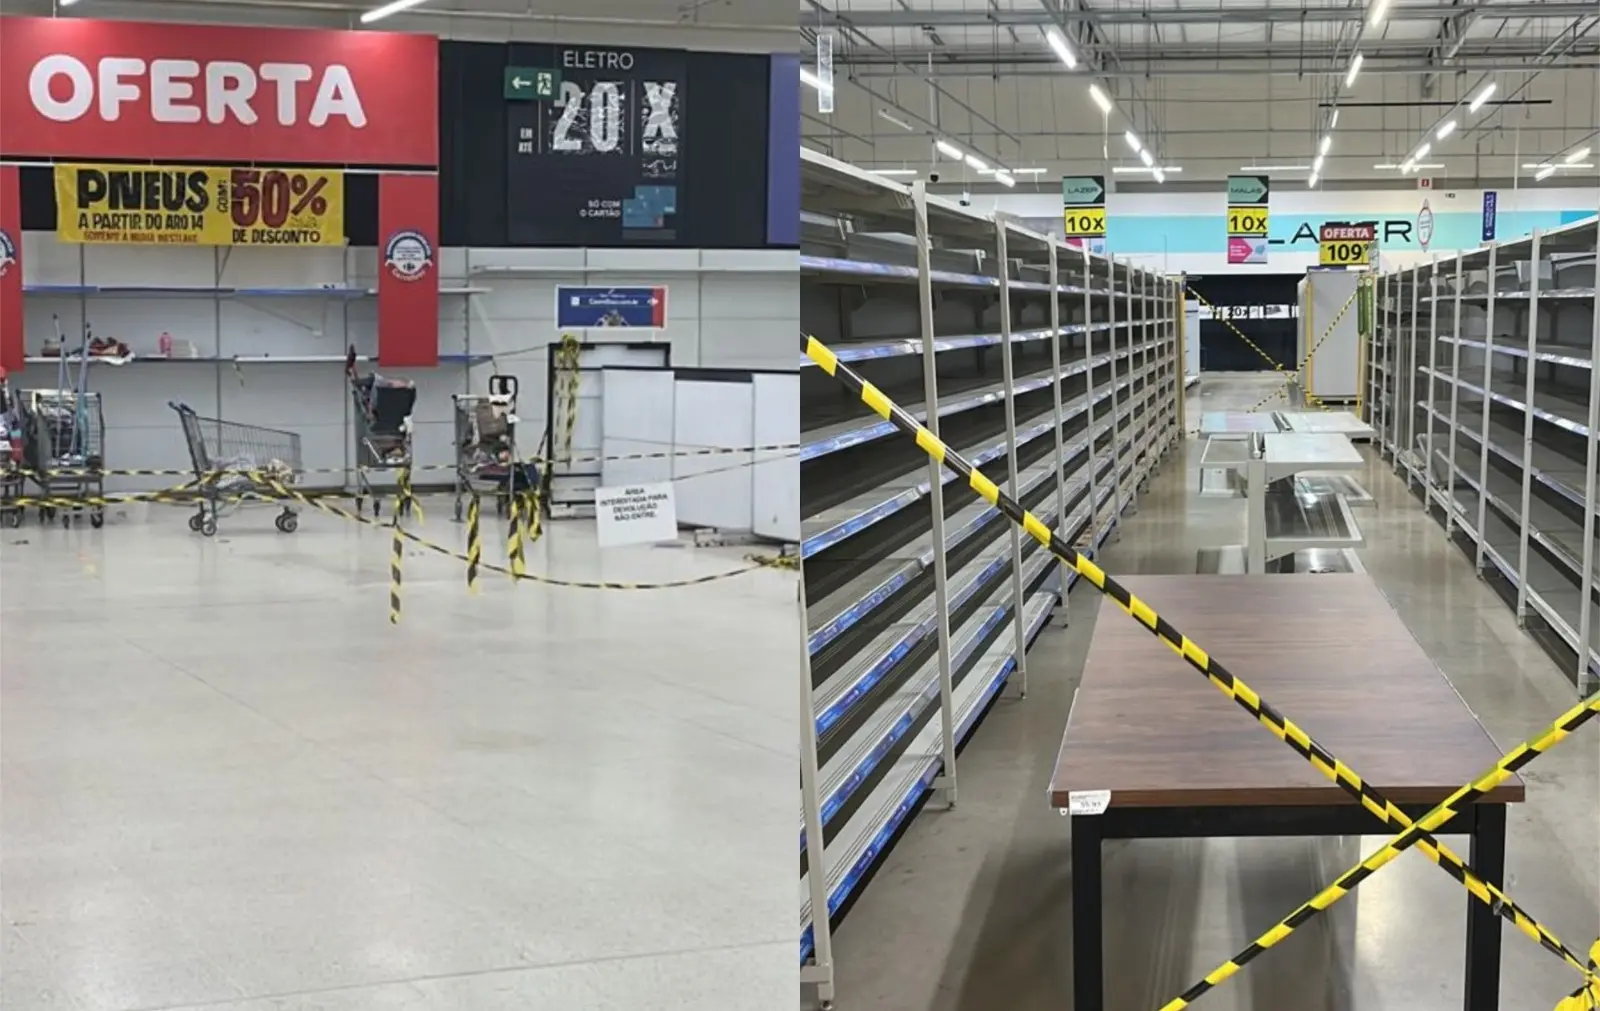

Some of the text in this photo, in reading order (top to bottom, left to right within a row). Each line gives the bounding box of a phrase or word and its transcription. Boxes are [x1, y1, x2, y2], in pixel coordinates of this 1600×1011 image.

[563, 50, 634, 70] ELETRO
[29, 54, 367, 128] OFERTA
[77, 169, 209, 212] PNEUS
[231, 169, 328, 228] 50%
[1067, 186, 1098, 194] LAZER
[79, 213, 89, 229] A
[144, 214, 162, 230] DO
[165, 214, 189, 230] ARO
[191, 214, 204, 230] 14
[232, 229, 321, 243] DE DESCONTO
[1324, 227, 1370, 239] OFERTA
[1327, 243, 1362, 261] 109
